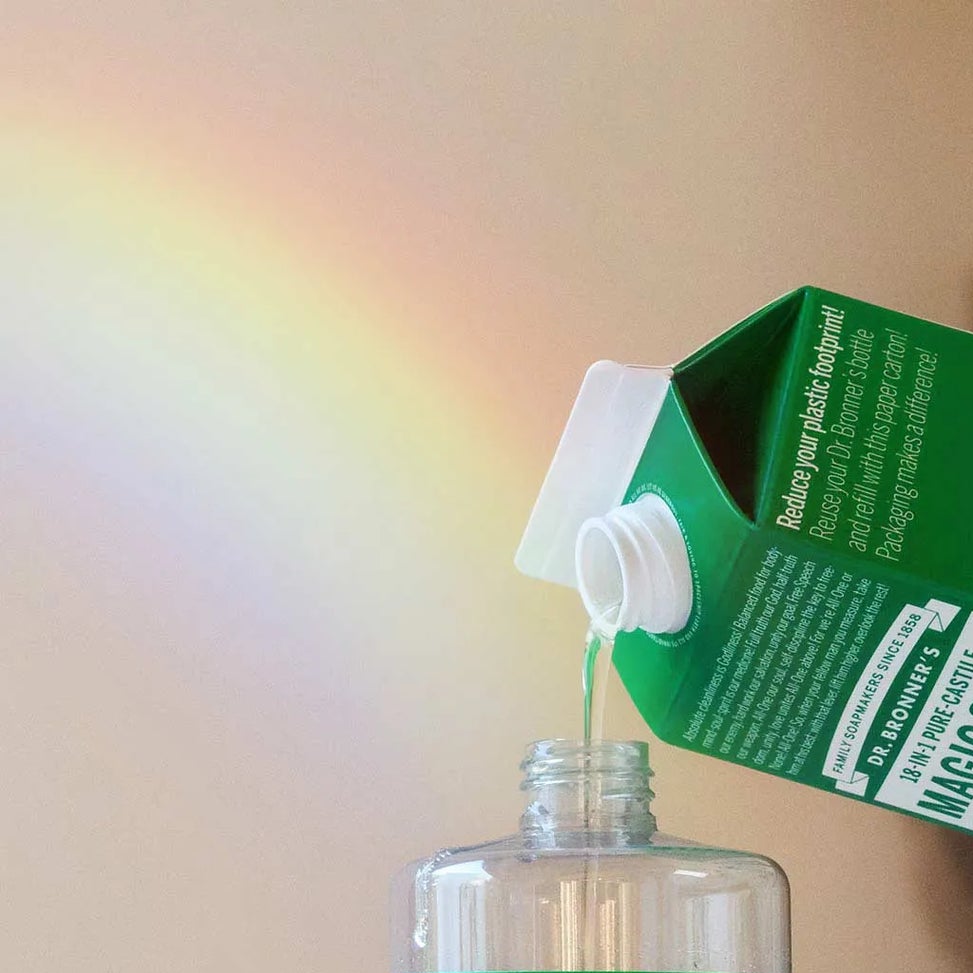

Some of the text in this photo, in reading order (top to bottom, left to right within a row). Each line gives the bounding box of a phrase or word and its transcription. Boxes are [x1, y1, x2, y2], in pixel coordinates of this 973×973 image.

[775, 304, 844, 530] Reduce your plastic footprint!
[809, 329, 874, 540] Reuse your Dr. Bronner's bottle
[848, 328, 907, 551] and refill with this paper carton!
[875, 347, 937, 560] Packaging makes a difference!
[832, 613, 921, 773] FAMILY SOAPMAKERS SINCE 1858
[867, 646, 939, 766] DR. BRONNER'S
[899, 742, 936, 783] 18-IN-1
